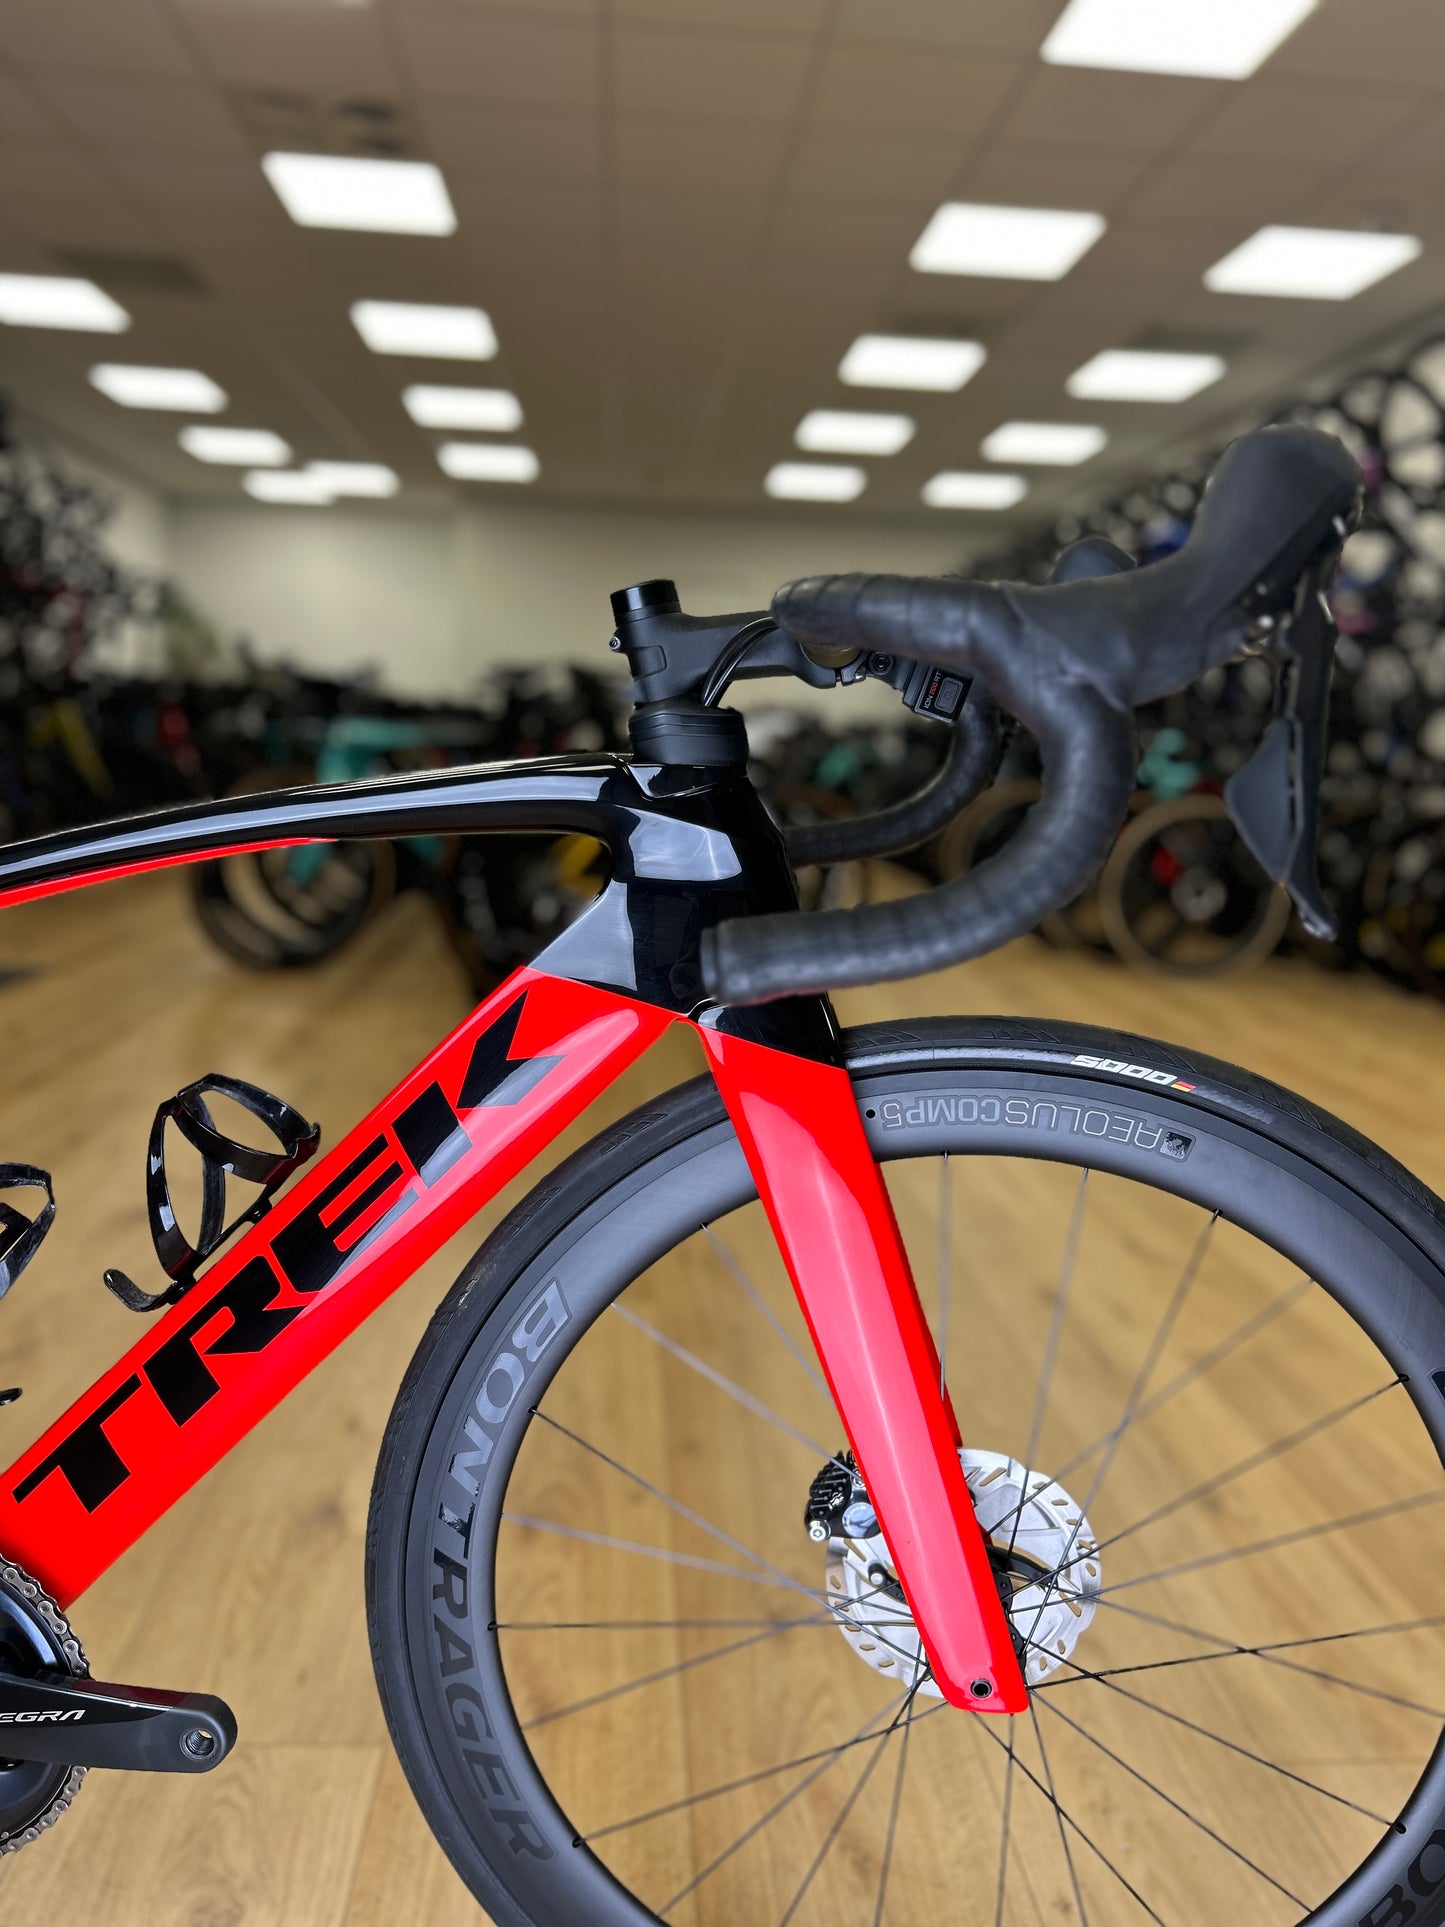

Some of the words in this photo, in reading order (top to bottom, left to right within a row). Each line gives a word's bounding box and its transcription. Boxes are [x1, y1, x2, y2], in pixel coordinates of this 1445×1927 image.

[924, 695, 933, 709] ION
[1070, 1054, 1178, 1086] 5000
[12, 988, 568, 1514] TREK
[431, 1279, 571, 1862] BONTRAGER
